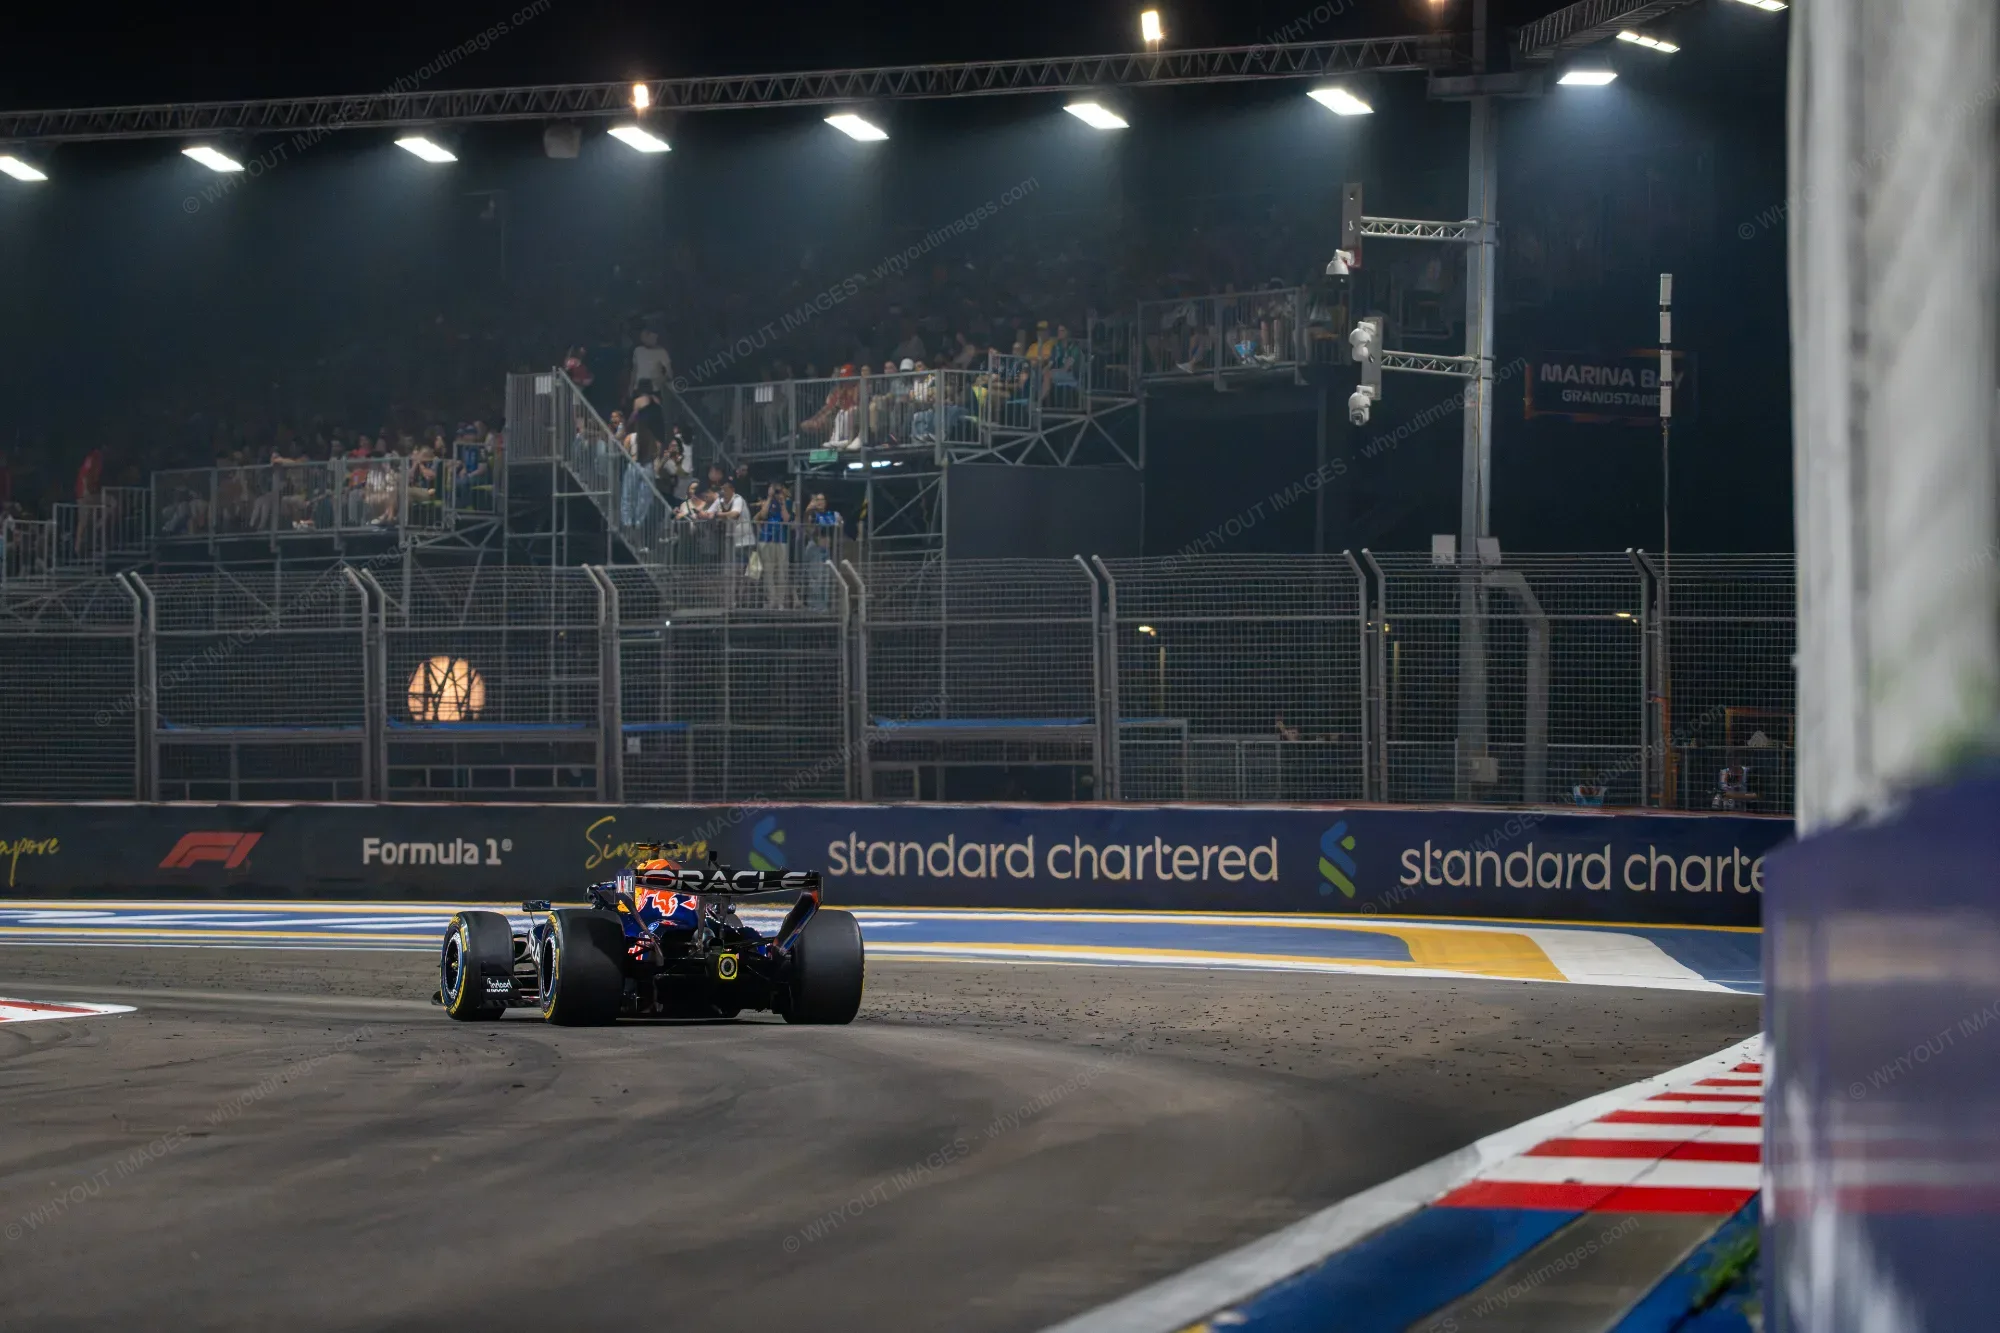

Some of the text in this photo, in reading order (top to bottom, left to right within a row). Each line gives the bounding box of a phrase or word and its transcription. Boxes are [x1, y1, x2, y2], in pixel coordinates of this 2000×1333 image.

[1540, 363, 1685, 390] MARINA BY
[362, 837, 479, 865] Formula
[828, 831, 1279, 882] standard chartered
[1399, 839, 1611, 890] standard
[642, 869, 808, 892] ORACLE
